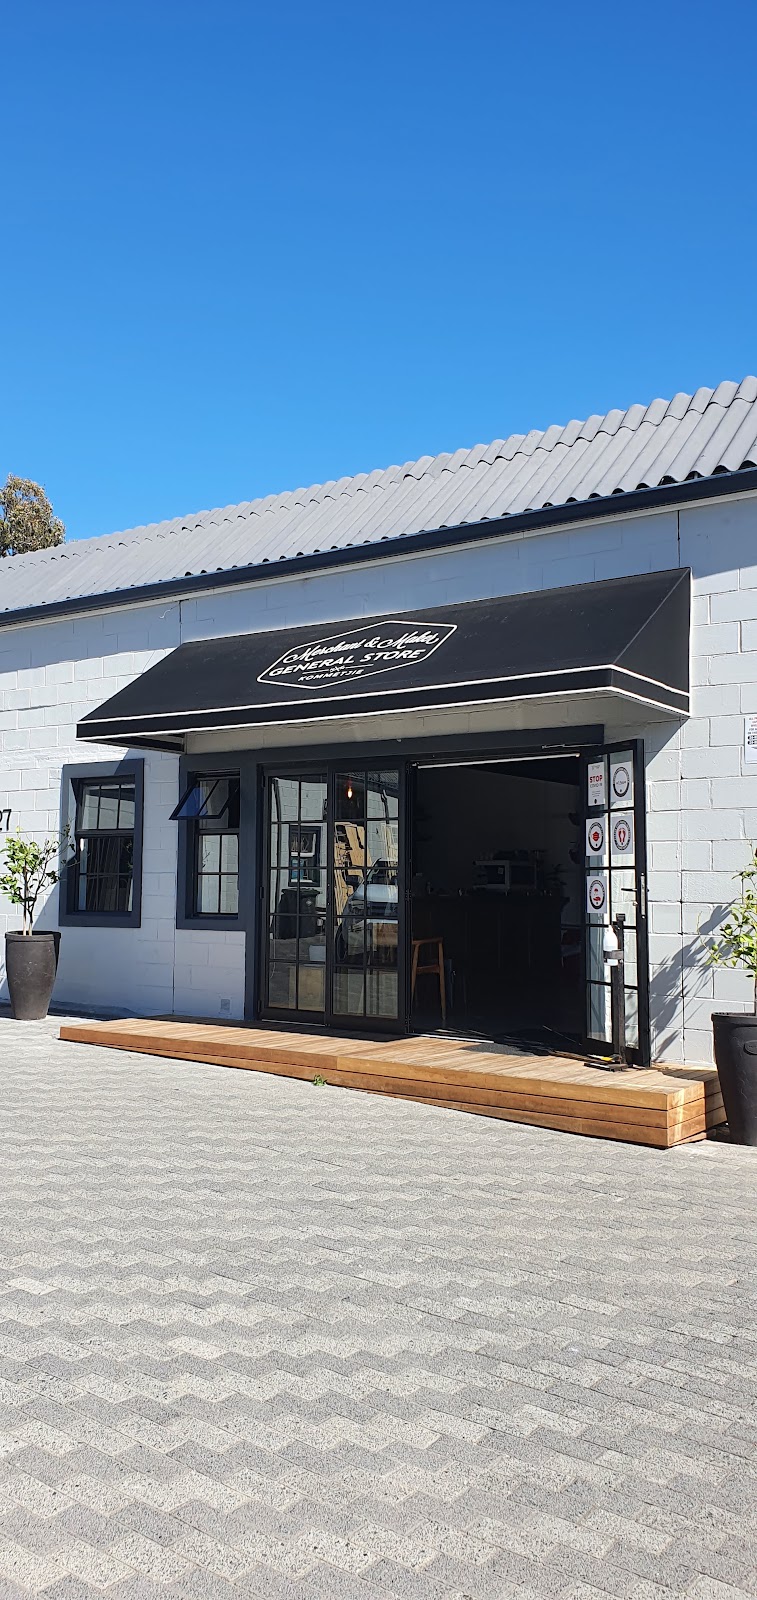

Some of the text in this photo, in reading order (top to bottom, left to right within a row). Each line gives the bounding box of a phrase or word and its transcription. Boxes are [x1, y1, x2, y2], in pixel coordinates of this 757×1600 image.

[282, 630, 440, 663] Merchant & Maker
[269, 649, 427, 677] GENERAL STORE
[297, 669, 365, 681] KOMMETJIE
[589, 774, 603, 783] STOP
[0, 808, 12, 831] 7
